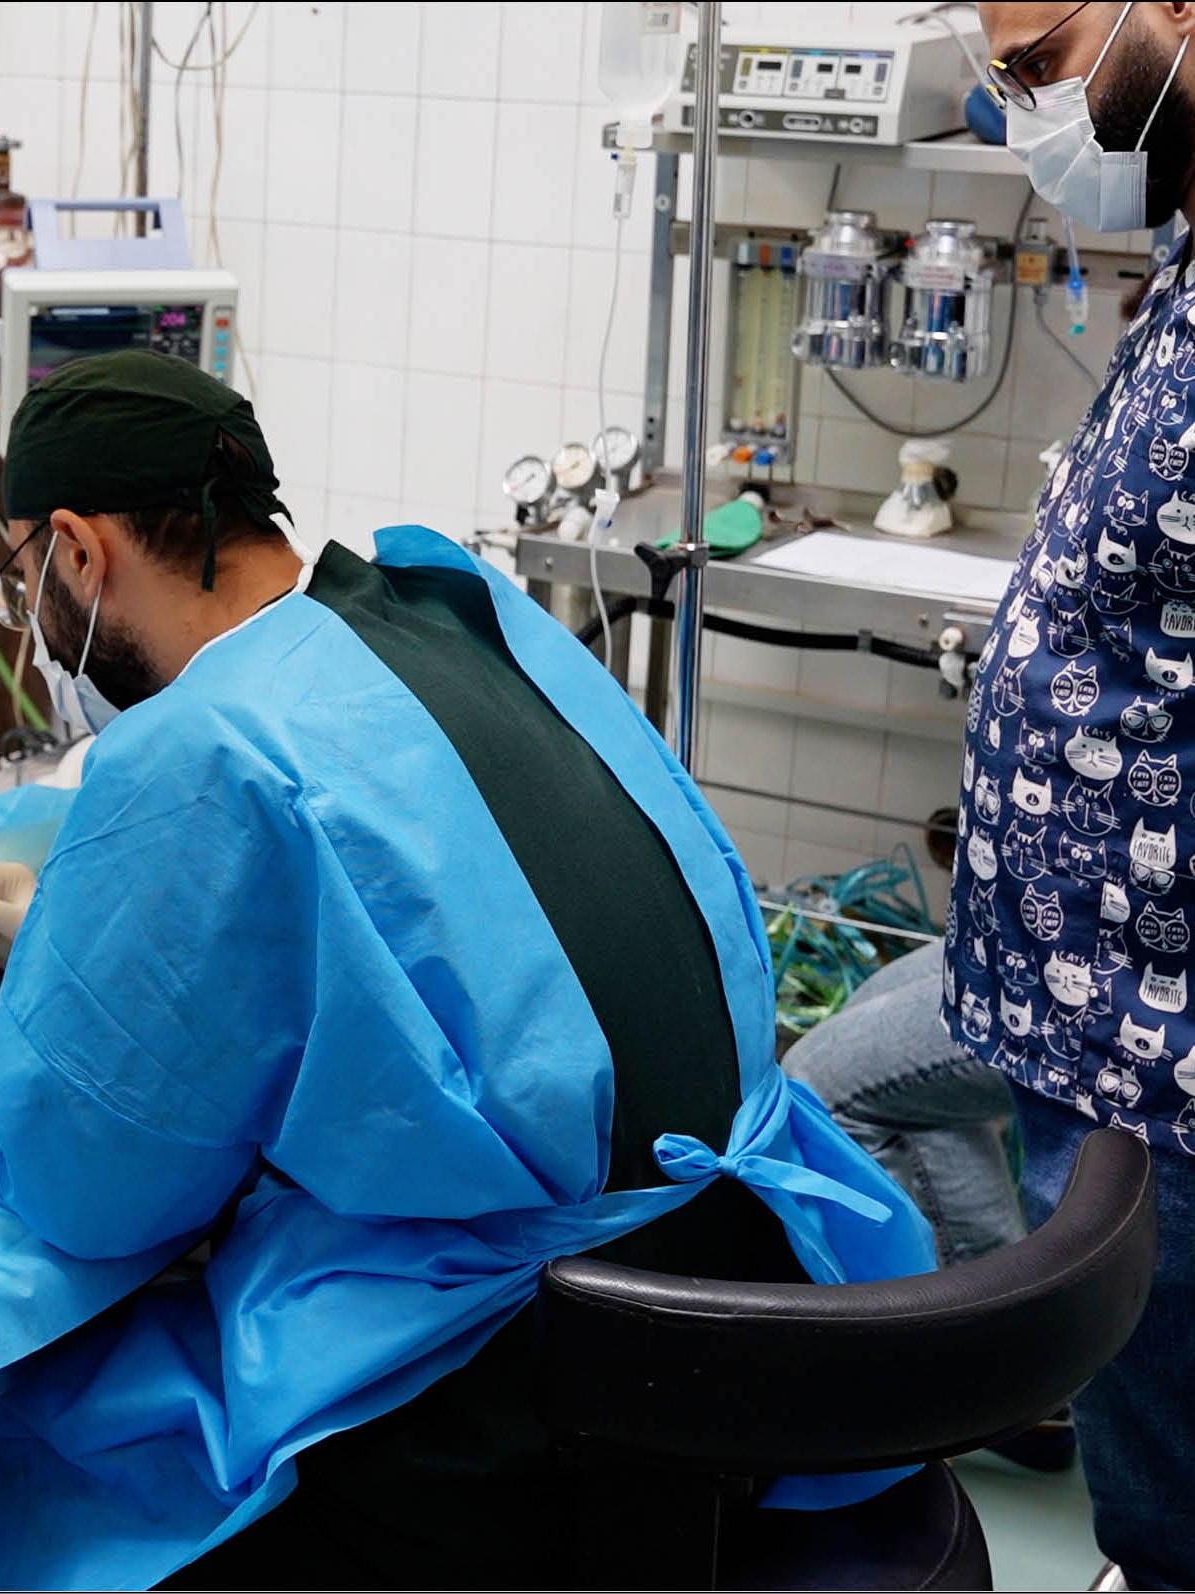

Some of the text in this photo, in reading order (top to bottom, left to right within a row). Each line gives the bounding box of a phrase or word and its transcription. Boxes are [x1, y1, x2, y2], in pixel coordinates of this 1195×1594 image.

[1084, 725, 1110, 740] CATS
[1133, 840, 1171, 863] FAVORITE
[1059, 951, 1086, 967] CATS
[1144, 982, 1183, 1006] FAVORITE
